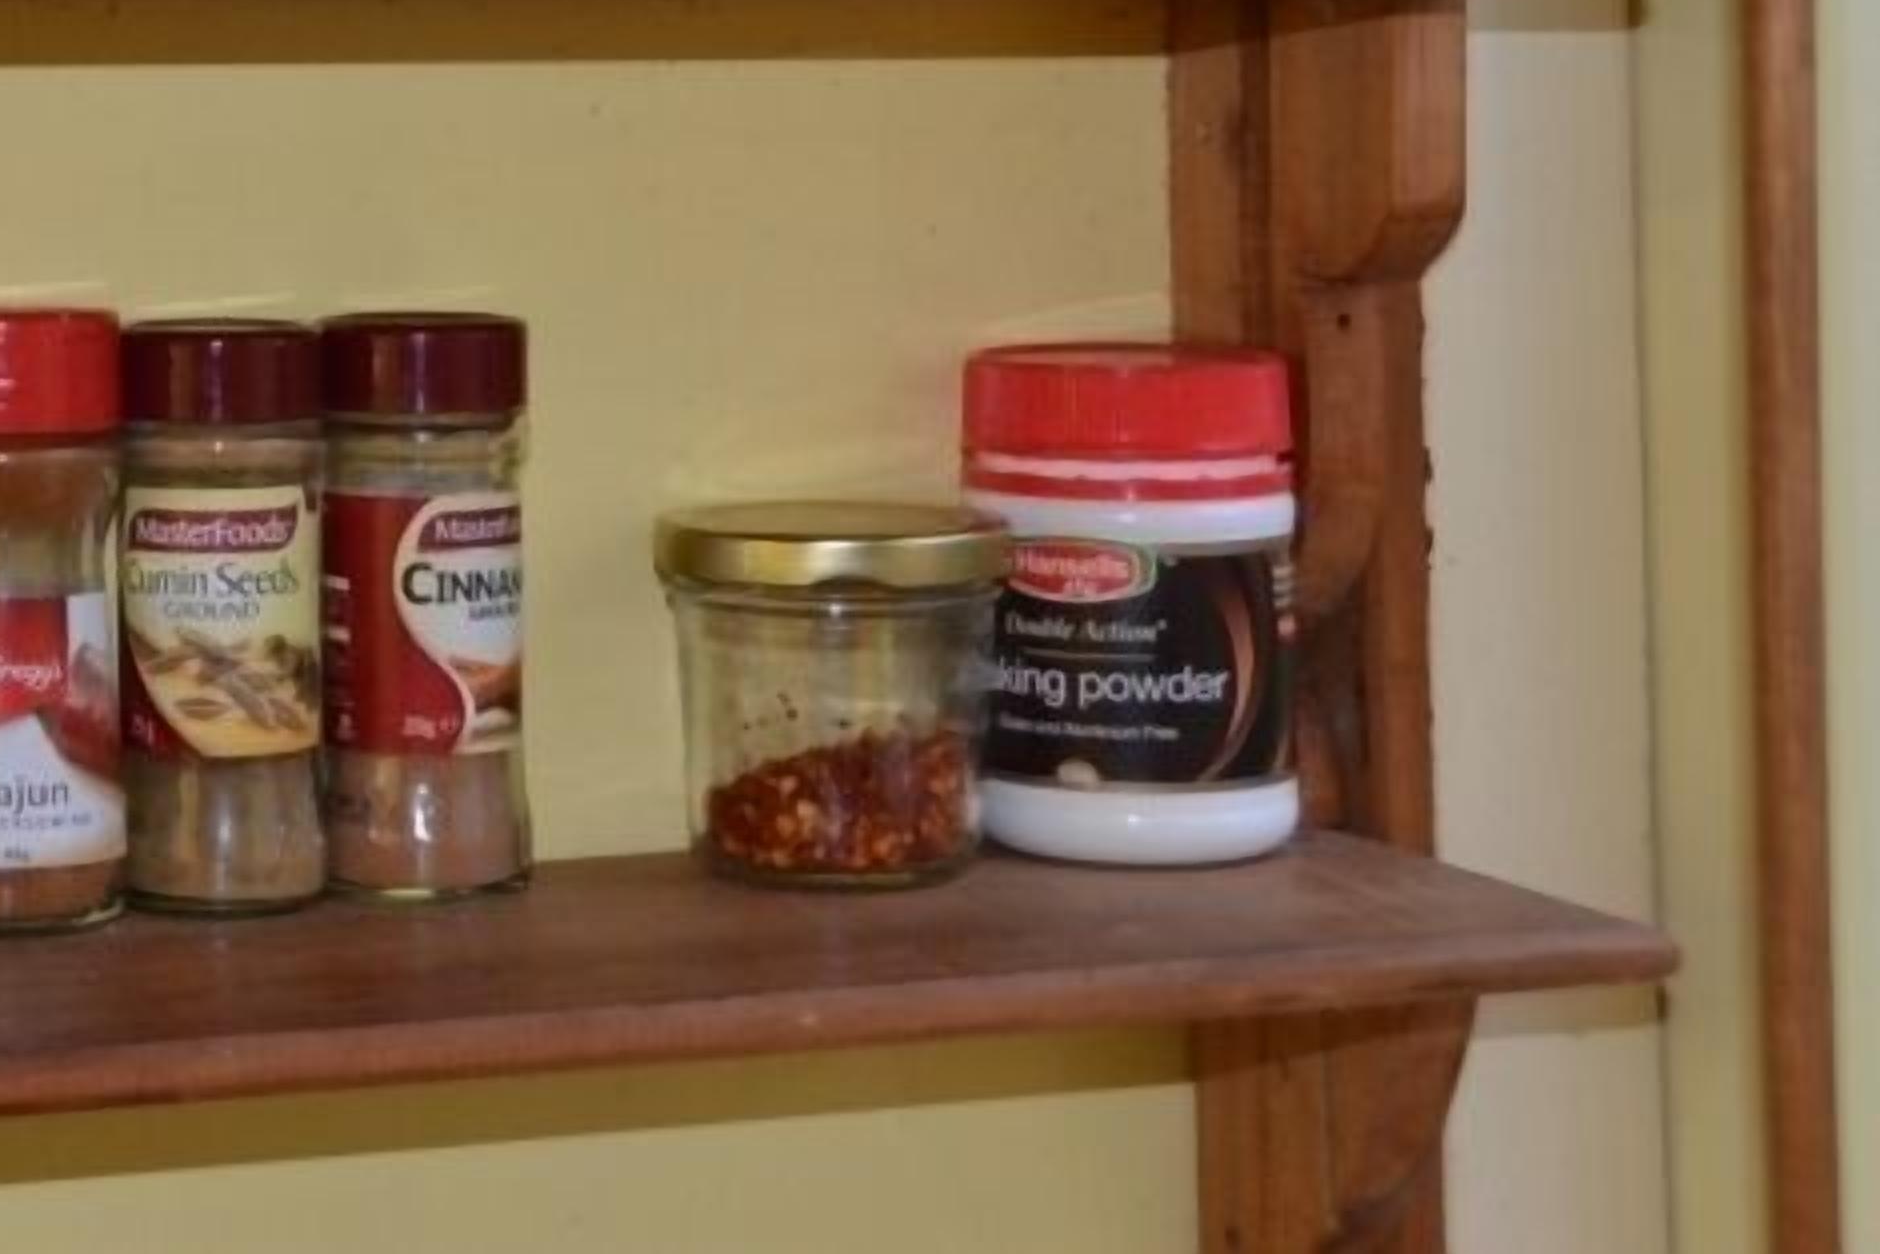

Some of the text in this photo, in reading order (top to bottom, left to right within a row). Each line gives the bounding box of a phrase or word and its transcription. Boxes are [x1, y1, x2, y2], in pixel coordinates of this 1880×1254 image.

[134, 516, 289, 545] MasterFoods
[215, 555, 300, 598] Seeds
[401, 562, 521, 605] CINNA
[1078, 665, 1230, 709] powder
